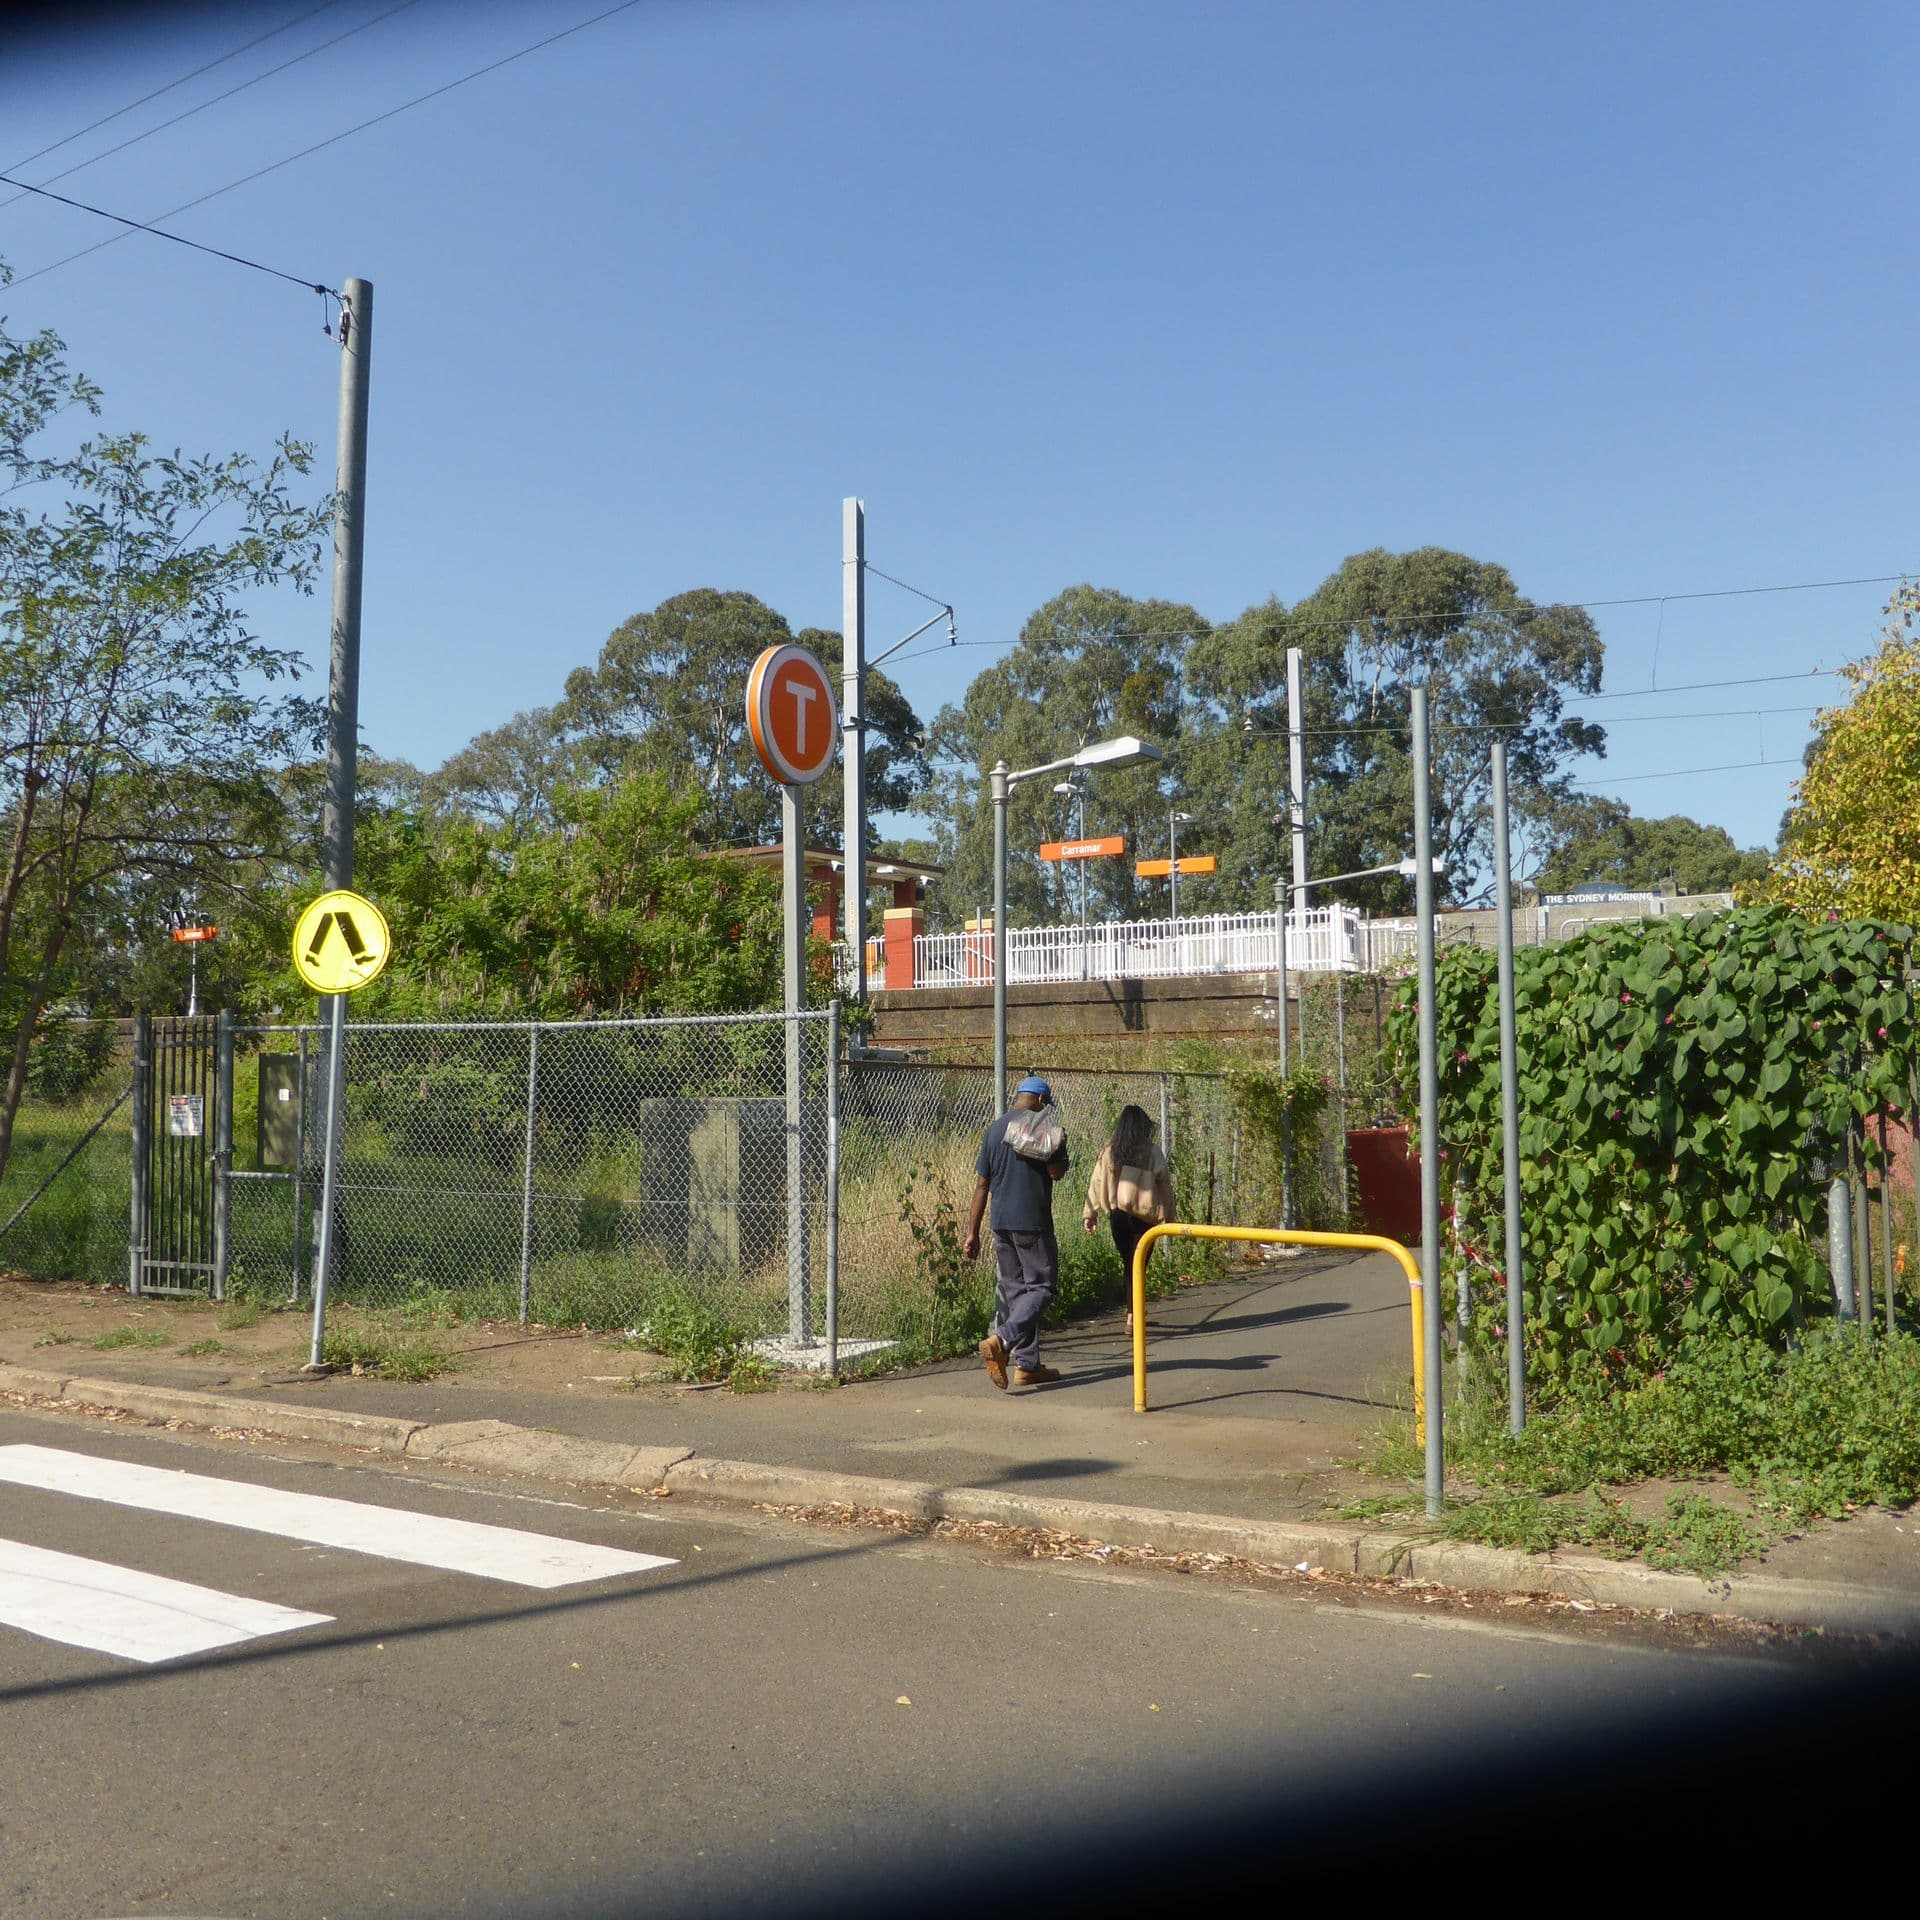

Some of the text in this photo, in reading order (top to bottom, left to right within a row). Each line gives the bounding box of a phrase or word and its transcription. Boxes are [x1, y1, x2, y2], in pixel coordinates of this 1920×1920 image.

[786, 680, 817, 755] T
[1061, 845, 1102, 856] Carramar
[1545, 892, 1653, 904] THE SYDNEY MORNING
